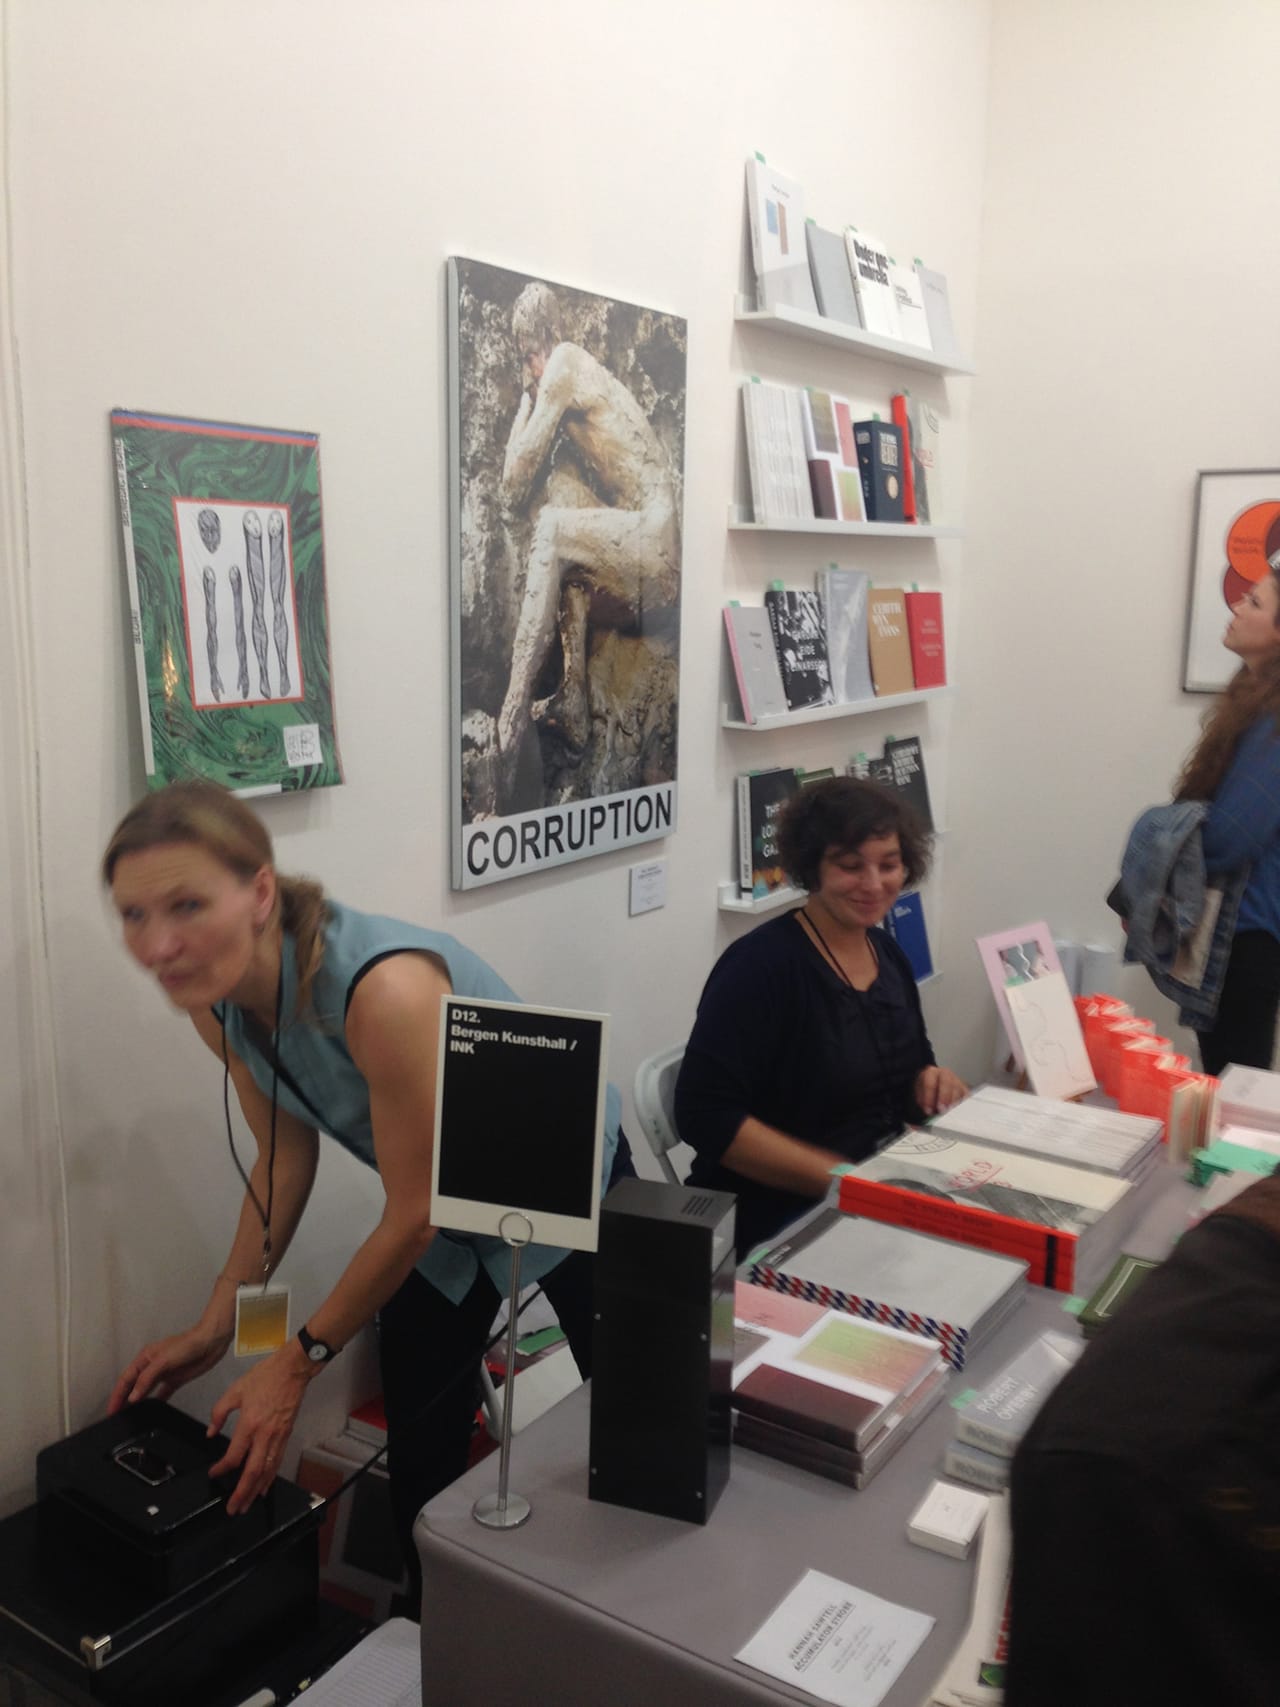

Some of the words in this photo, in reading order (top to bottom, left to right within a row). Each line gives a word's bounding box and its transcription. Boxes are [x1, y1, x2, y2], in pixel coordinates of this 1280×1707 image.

[467, 789, 672, 876] CORRUPTION
[451, 1008, 481, 1023] D12.
[450, 1040, 475, 1055] INK
[451, 1025, 498, 1042] Bergen
[502, 1031, 567, 1051] Kunsthall
[794, 1624, 834, 1672] ACCUMULATOR
